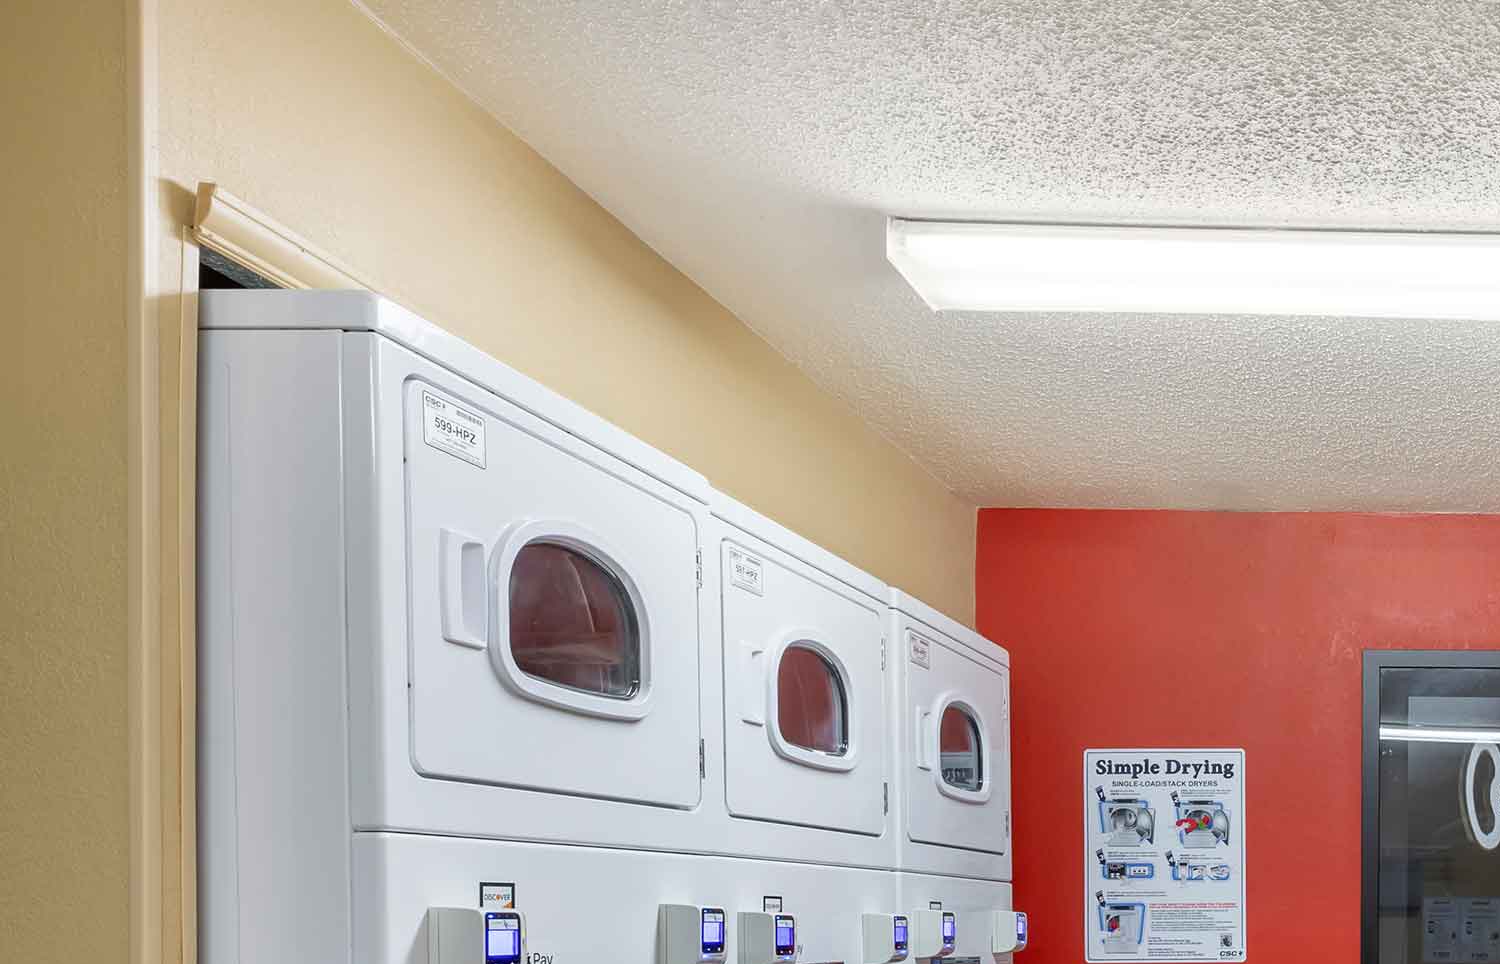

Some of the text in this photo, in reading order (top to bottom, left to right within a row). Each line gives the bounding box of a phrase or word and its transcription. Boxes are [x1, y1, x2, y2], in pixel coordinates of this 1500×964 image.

[434, 416, 477, 445] 599-HPZ
[1096, 759, 1234, 779] Simple Drying
